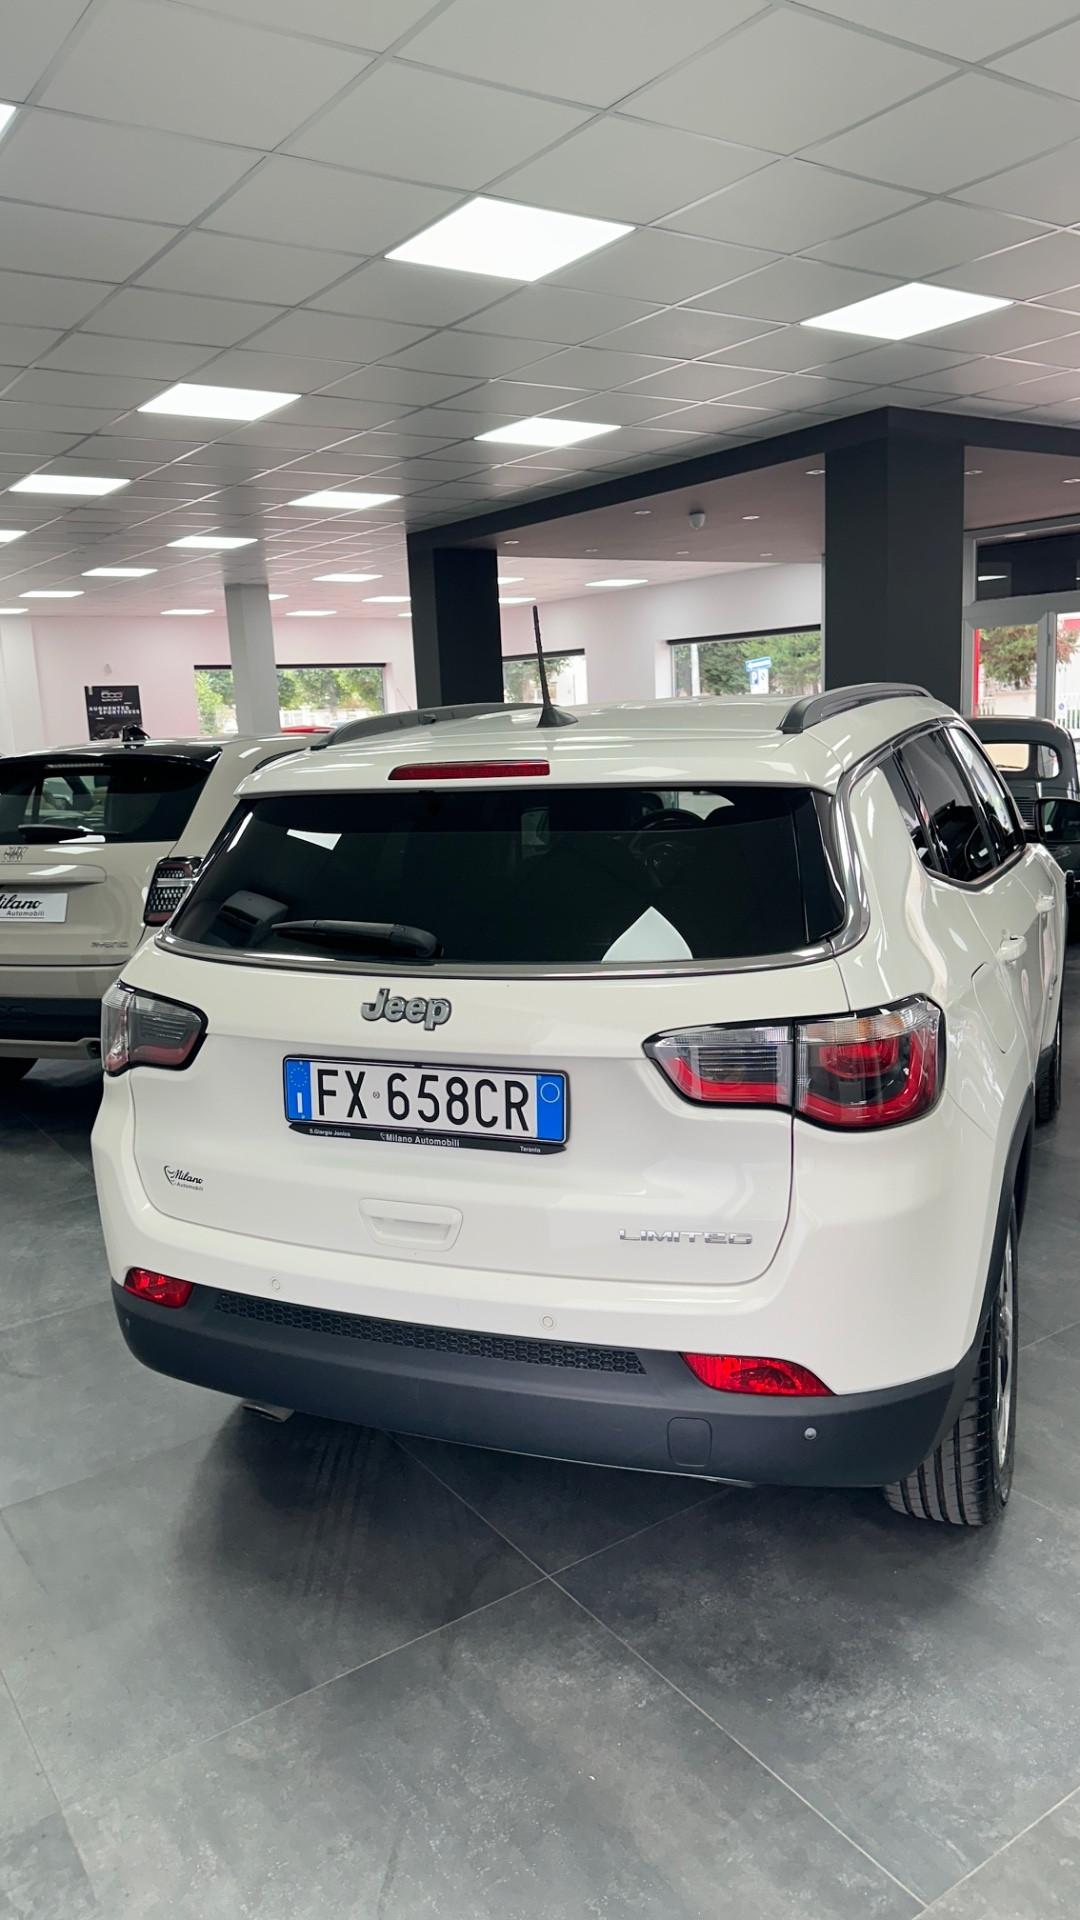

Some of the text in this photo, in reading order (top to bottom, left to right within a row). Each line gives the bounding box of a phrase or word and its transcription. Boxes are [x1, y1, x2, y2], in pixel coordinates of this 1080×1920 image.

[361, 987, 452, 1031] Jeep
[317, 1068, 368, 1119] FX
[387, 1072, 529, 1132] 658CR
[386, 1132, 460, 1147] Milano Automobili
[175, 1169, 204, 1185] Milano
[619, 1229, 752, 1245] LIMITED
